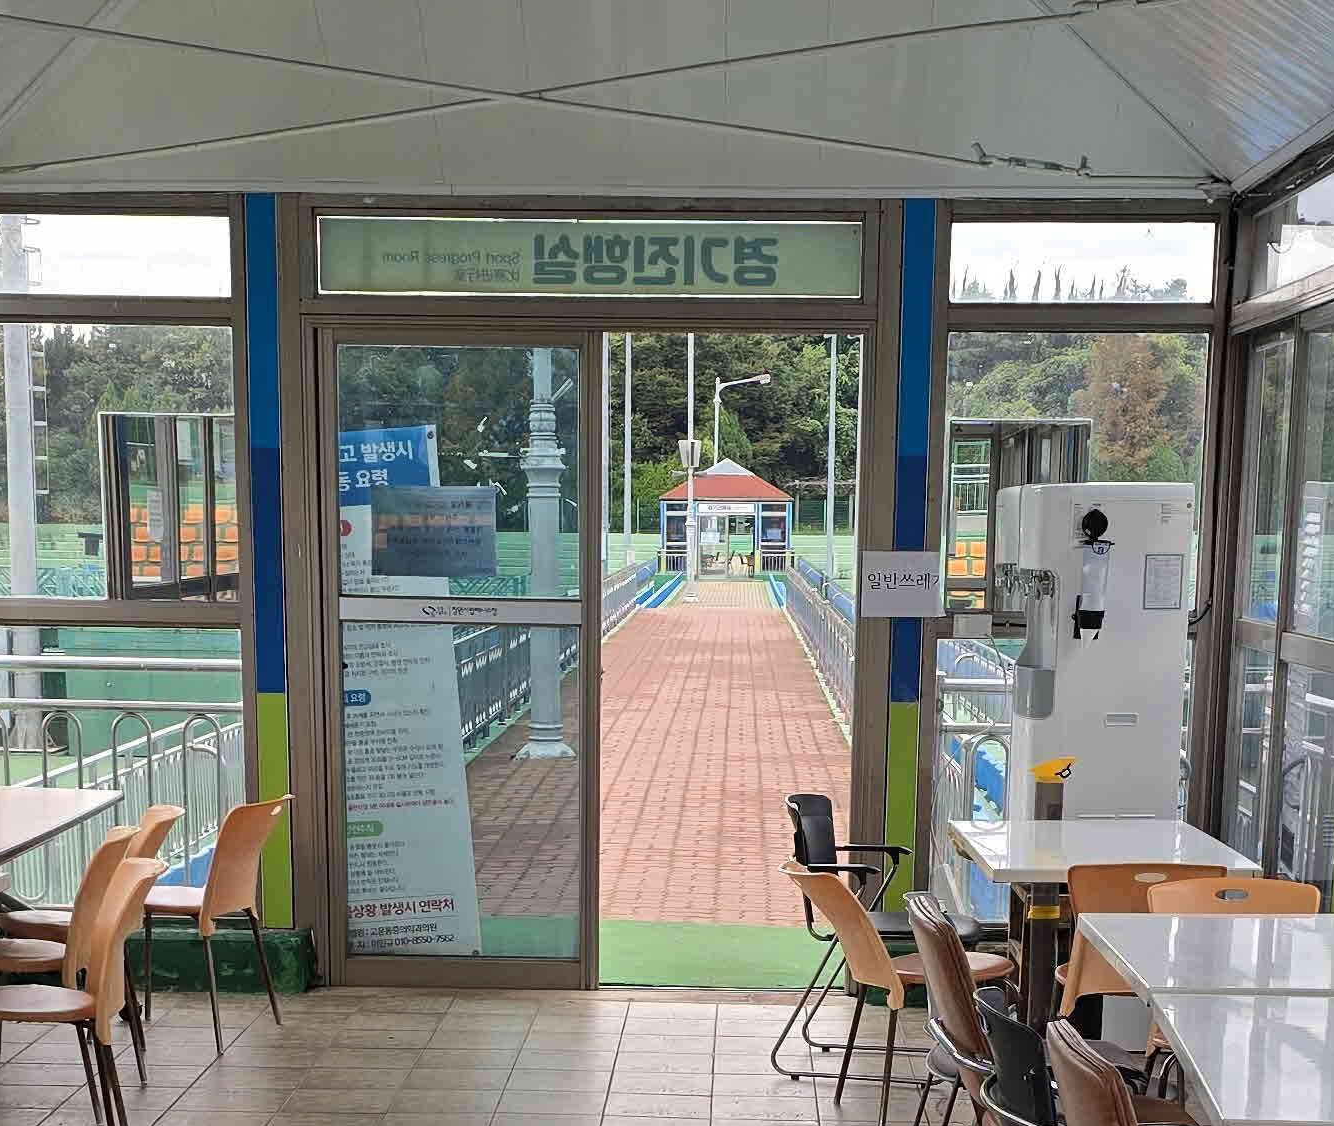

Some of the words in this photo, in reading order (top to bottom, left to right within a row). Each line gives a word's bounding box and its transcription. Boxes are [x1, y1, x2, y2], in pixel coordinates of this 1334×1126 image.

[361, 440, 413, 463] 발생시
[355, 468, 389, 488] 요령
[379, 900, 416, 916] 발생시
[419, 897, 455, 913] 연락처
